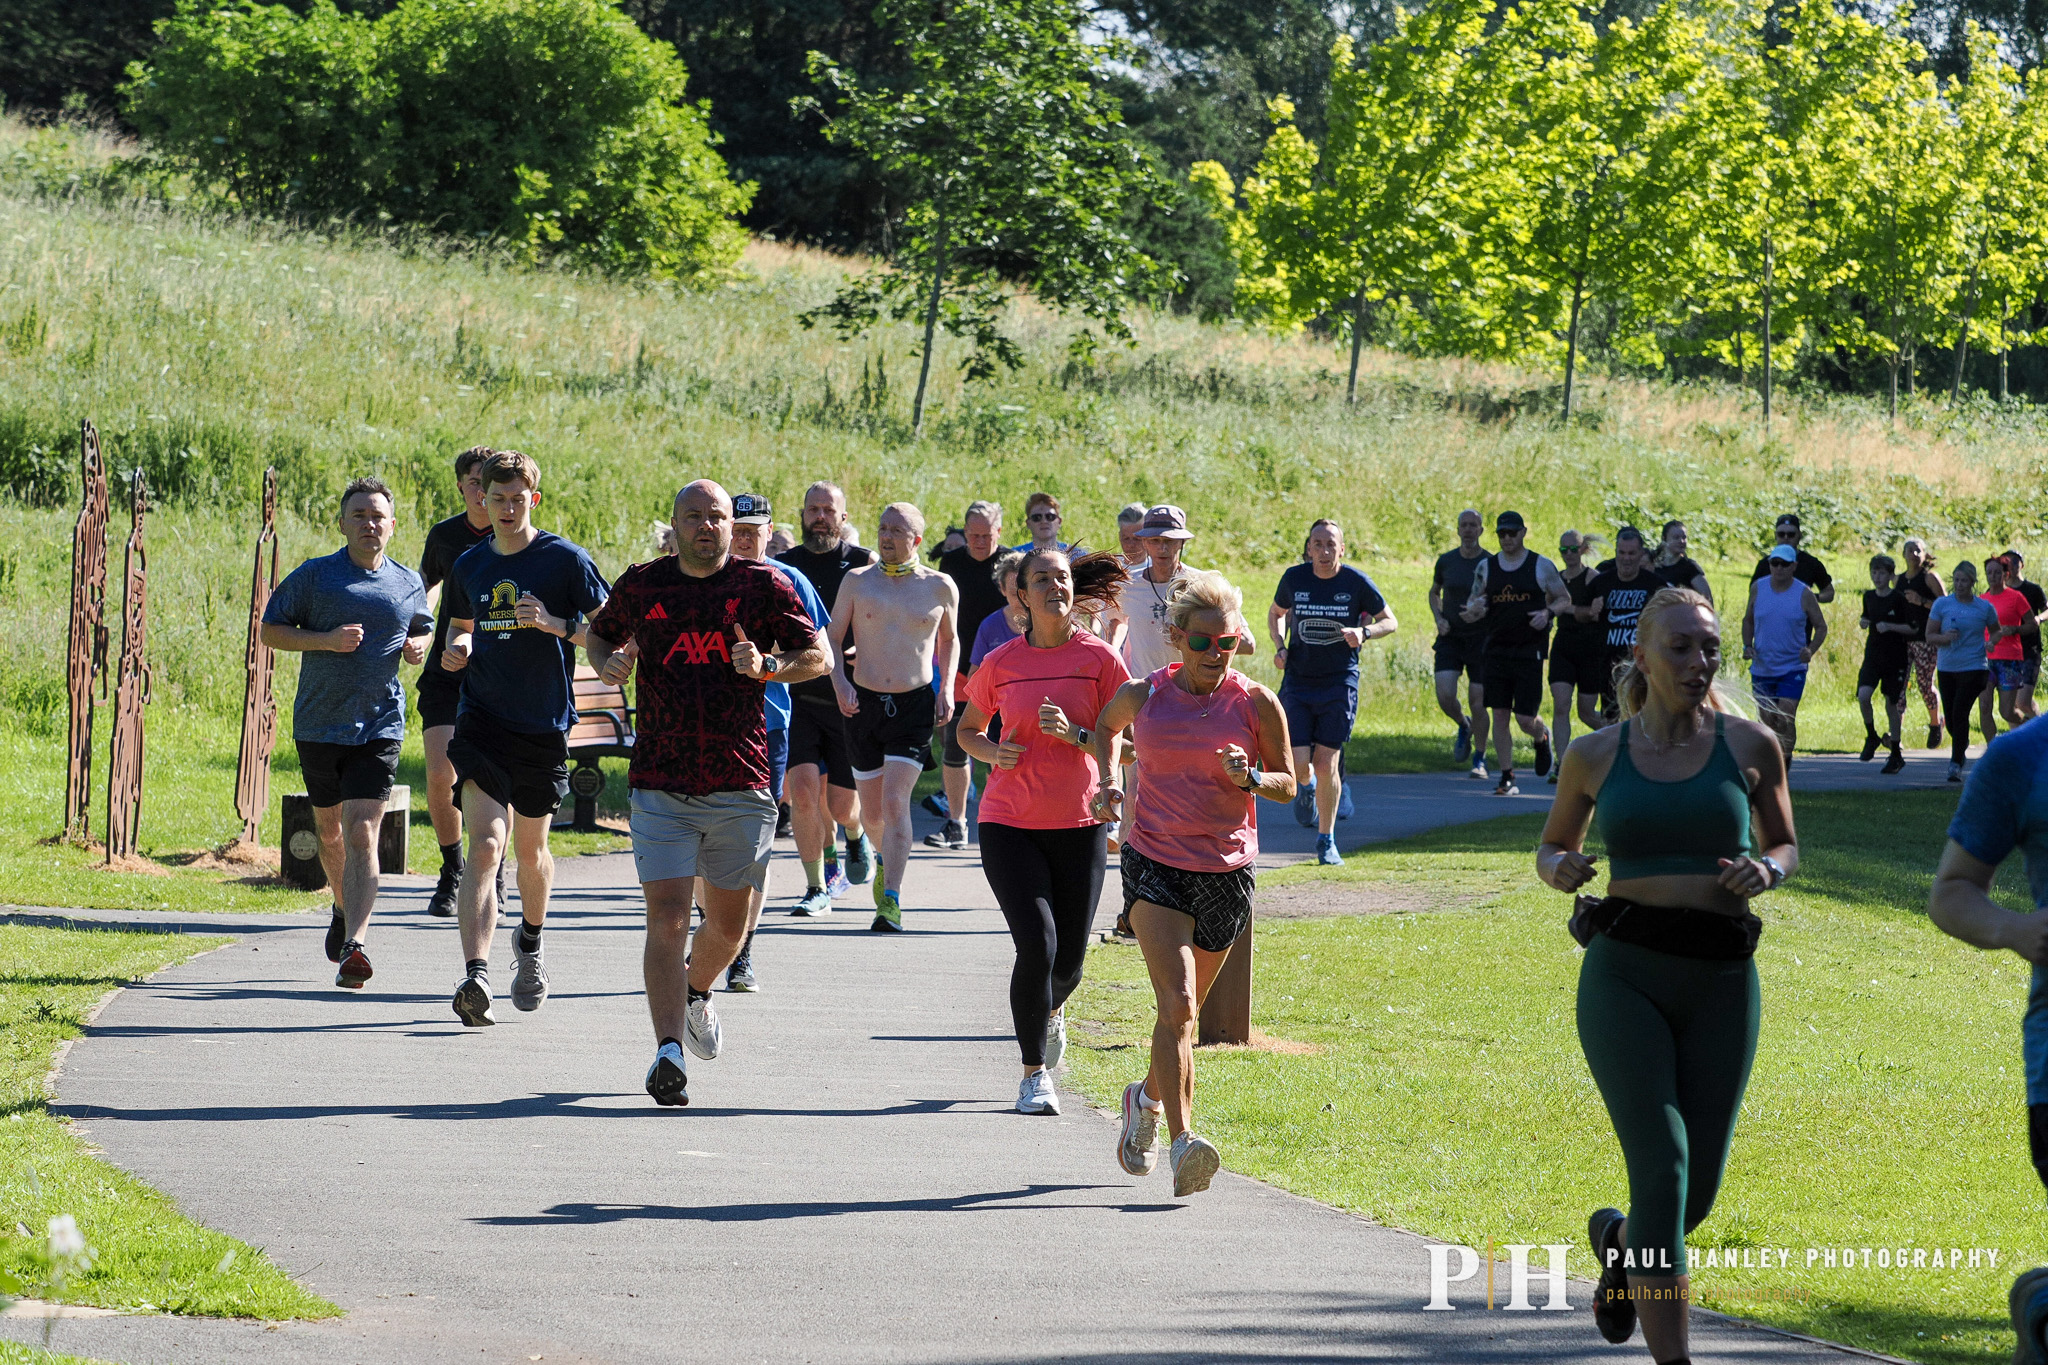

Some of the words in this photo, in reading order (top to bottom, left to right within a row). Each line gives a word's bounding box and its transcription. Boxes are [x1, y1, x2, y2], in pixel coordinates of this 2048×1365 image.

[481, 594, 488, 602] 20
[1492, 585, 1531, 603] parkrun
[1606, 589, 1647, 609] NIKE
[489, 610, 516, 619] MERSE
[480, 620, 516, 632] TUNNEL
[662, 631, 731, 665] AXA
